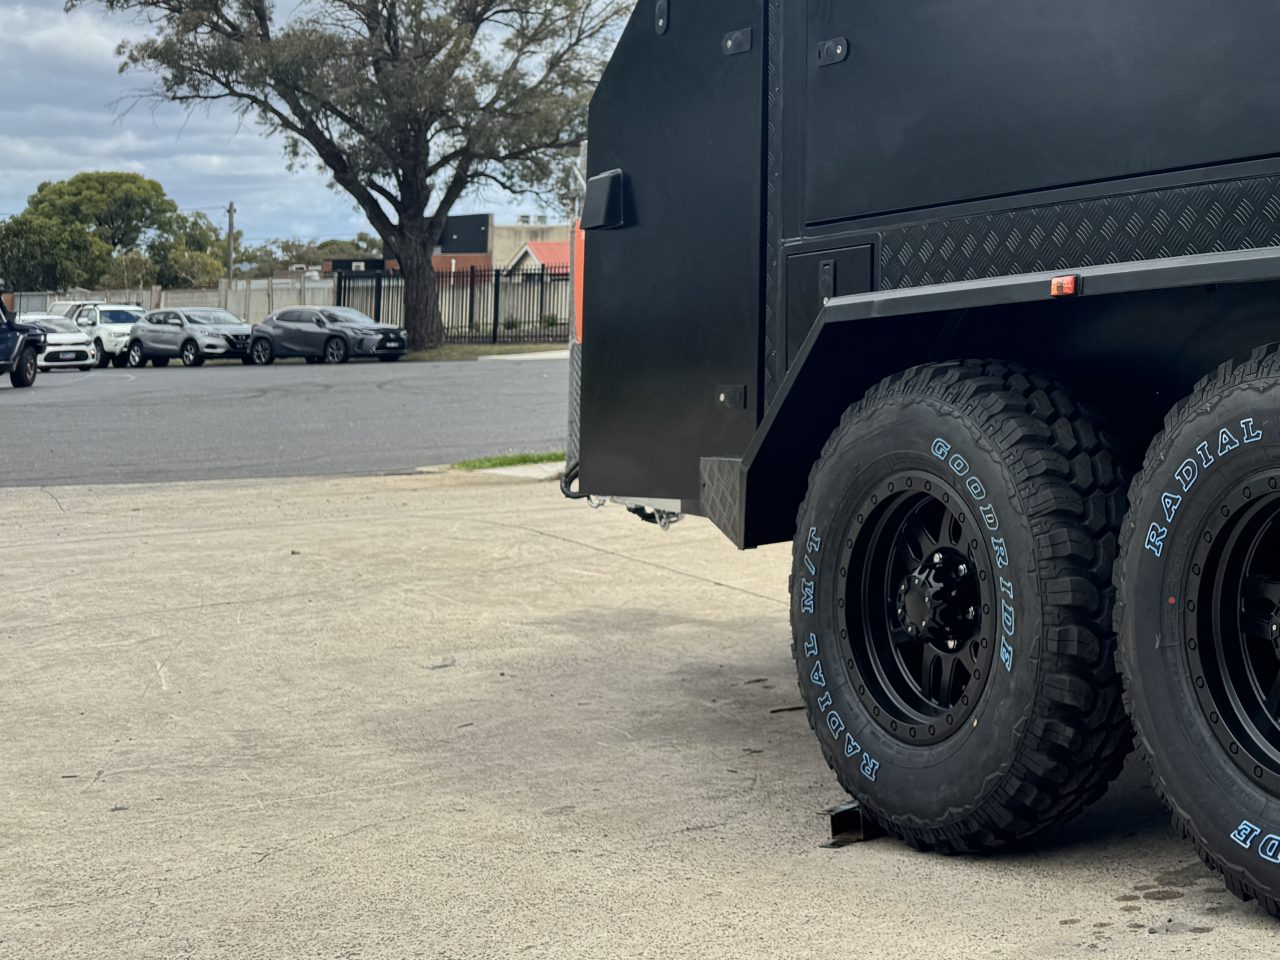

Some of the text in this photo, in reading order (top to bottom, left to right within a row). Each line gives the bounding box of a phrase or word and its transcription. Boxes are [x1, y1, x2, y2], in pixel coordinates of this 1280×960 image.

[931, 437, 1015, 673] GOODRIDE
[1145, 417, 1263, 557] RADIAL
[801, 527, 880, 782] RADIAL M/T
